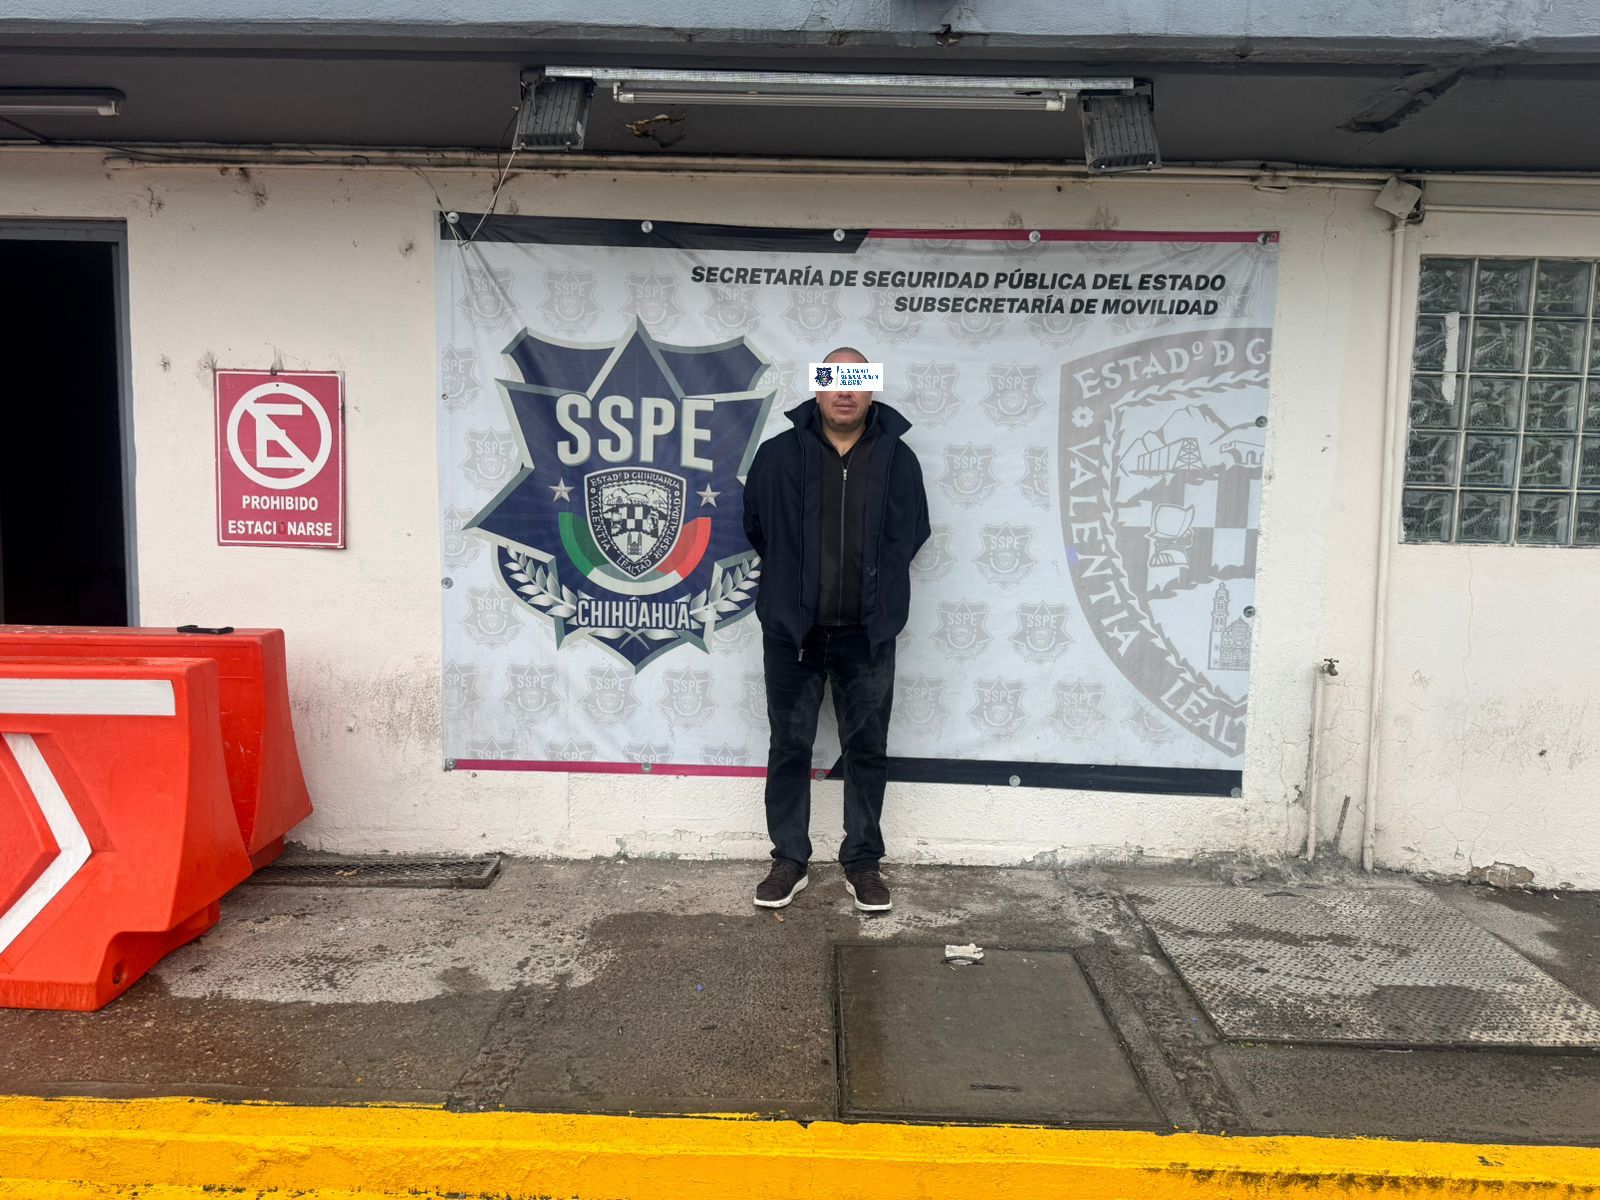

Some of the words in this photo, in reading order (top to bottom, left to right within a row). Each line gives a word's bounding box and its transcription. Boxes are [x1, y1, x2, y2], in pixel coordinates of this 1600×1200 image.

[691, 265, 825, 287] SECRETARÍA
[829, 269, 858, 288] DE
[862, 270, 989, 289] SEGURIDAD
[993, 267, 1087, 290] PÚBLICA
[1091, 274, 1134, 291] DEL
[1138, 274, 1226, 292] ESTADO
[554, 281, 586, 297] SSPE
[636, 285, 667, 300] SSPE
[798, 289, 829, 305] SSPE
[894, 294, 1065, 315] SUBSECRETARÍA
[1070, 298, 1099, 315] DE
[1101, 298, 1219, 316] MOVILIDAD
[916, 375, 947, 389] SSPE
[998, 375, 1028, 391] SSPE
[555, 392, 716, 473] SSPE
[476, 441, 506, 456] SSPE
[953, 456, 985, 471] SSPE
[242, 495, 319, 512] PROHIBIDO
[228, 519, 333, 537] ESTACINARSE
[590, 495, 611, 551] VALENTIA
[990, 536, 1021, 550] SSPE
[616, 556, 653, 576] LEALTAD
[477, 598, 508, 613] SSPE
[576, 598, 690, 629] CHIHUAHUA
[947, 612, 977, 627] SSPE
[1026, 614, 1057, 629] SSPE
[517, 675, 548, 689] SSPE
[596, 677, 625, 692] SSPE
[673, 679, 703, 694] SSPE
[905, 687, 935, 702] SSPE
[984, 689, 1014, 704] SSPE
